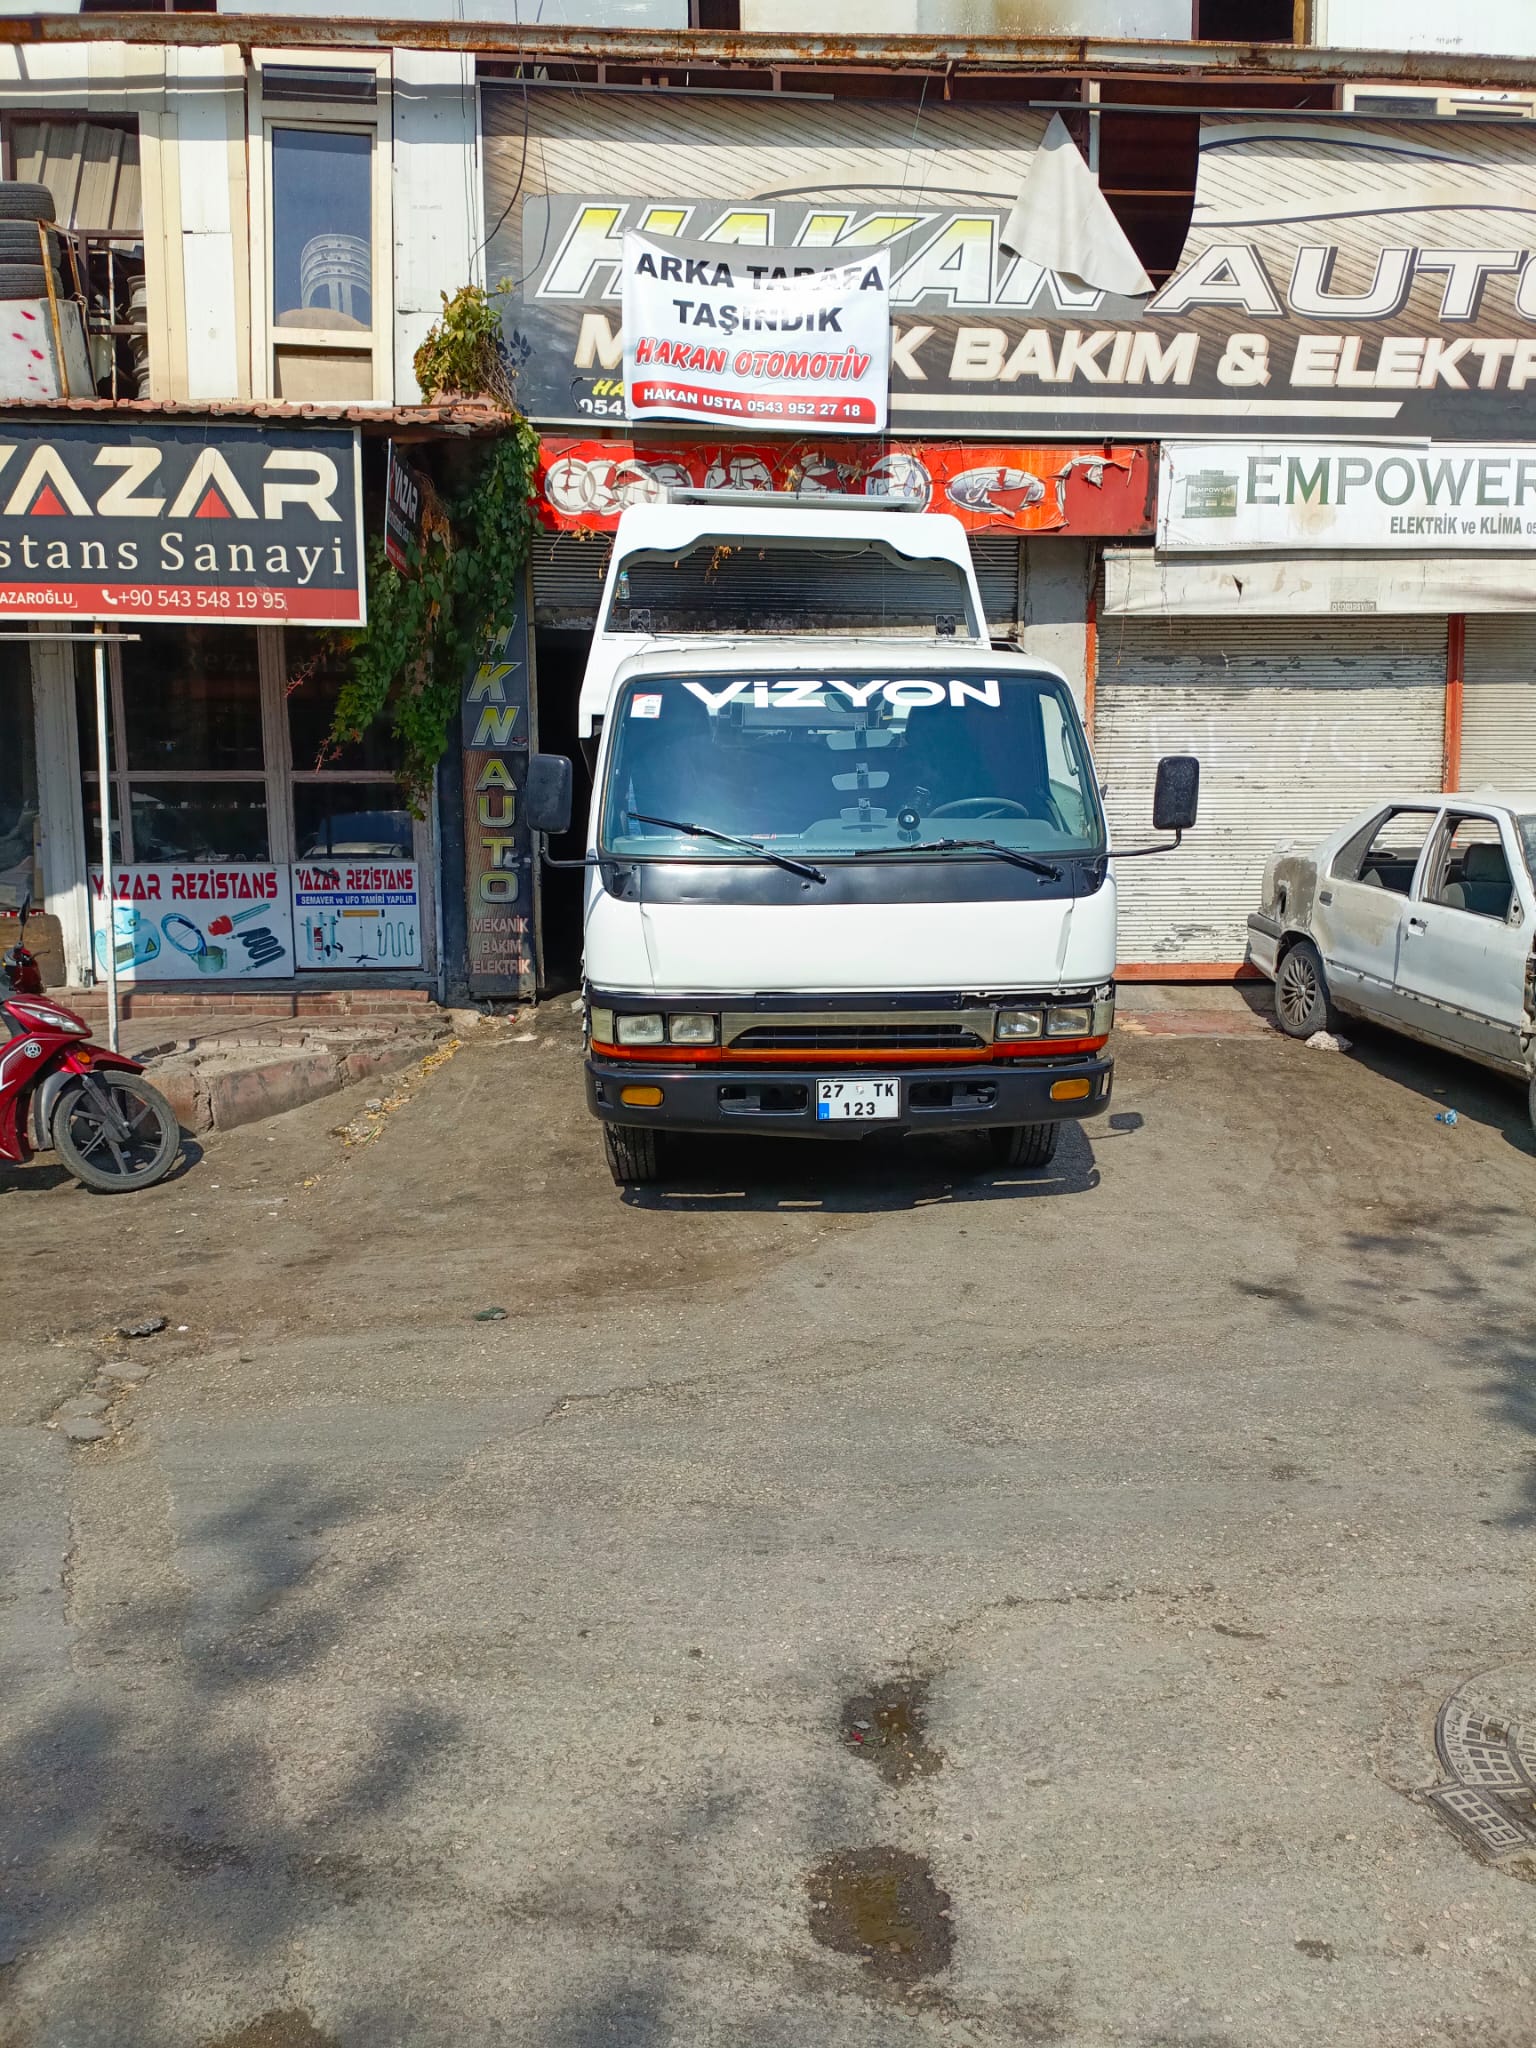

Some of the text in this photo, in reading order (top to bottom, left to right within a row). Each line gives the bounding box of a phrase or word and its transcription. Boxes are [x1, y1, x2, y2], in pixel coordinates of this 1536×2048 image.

[634, 252, 735, 288] ARKA
[673, 299, 843, 335] TAŞINDIK
[634, 337, 728, 374] HAKAN
[732, 345, 871, 381] OTOMOTİV
[949, 327, 1200, 385] BAKIM
[1217, 333, 1271, 387] &
[643, 388, 861, 417] HAKAN USTA 0543 952 27 18
[1390, 513, 1457, 534] ELEKTRİK
[1461, 521, 1476, 534] ve
[1480, 513, 1522, 534] KLİMA
[160, 532, 345, 585] Sanayi
[118, 589, 152, 607] +90
[157, 590, 191, 608] 543
[196, 591, 230, 609] 548
[236, 593, 257, 609] 19
[263, 593, 285, 609] 95
[474, 759, 519, 903] AUTO
[172, 868, 277, 900] REZİSTANS
[346, 867, 413, 890] REZİSTANS
[301, 896, 334, 905] SEMAVER
[345, 895, 360, 904] UFO
[361, 893, 385, 904] TAMİRİ
[386, 895, 413, 904] YAPILIR
[472, 914, 529, 933] MEKANİK
[482, 939, 522, 954] BAKIM
[472, 956, 531, 975] ELEKTRİK
[822, 1083, 894, 1099] 27 TK
[844, 1102, 876, 1116] 123
